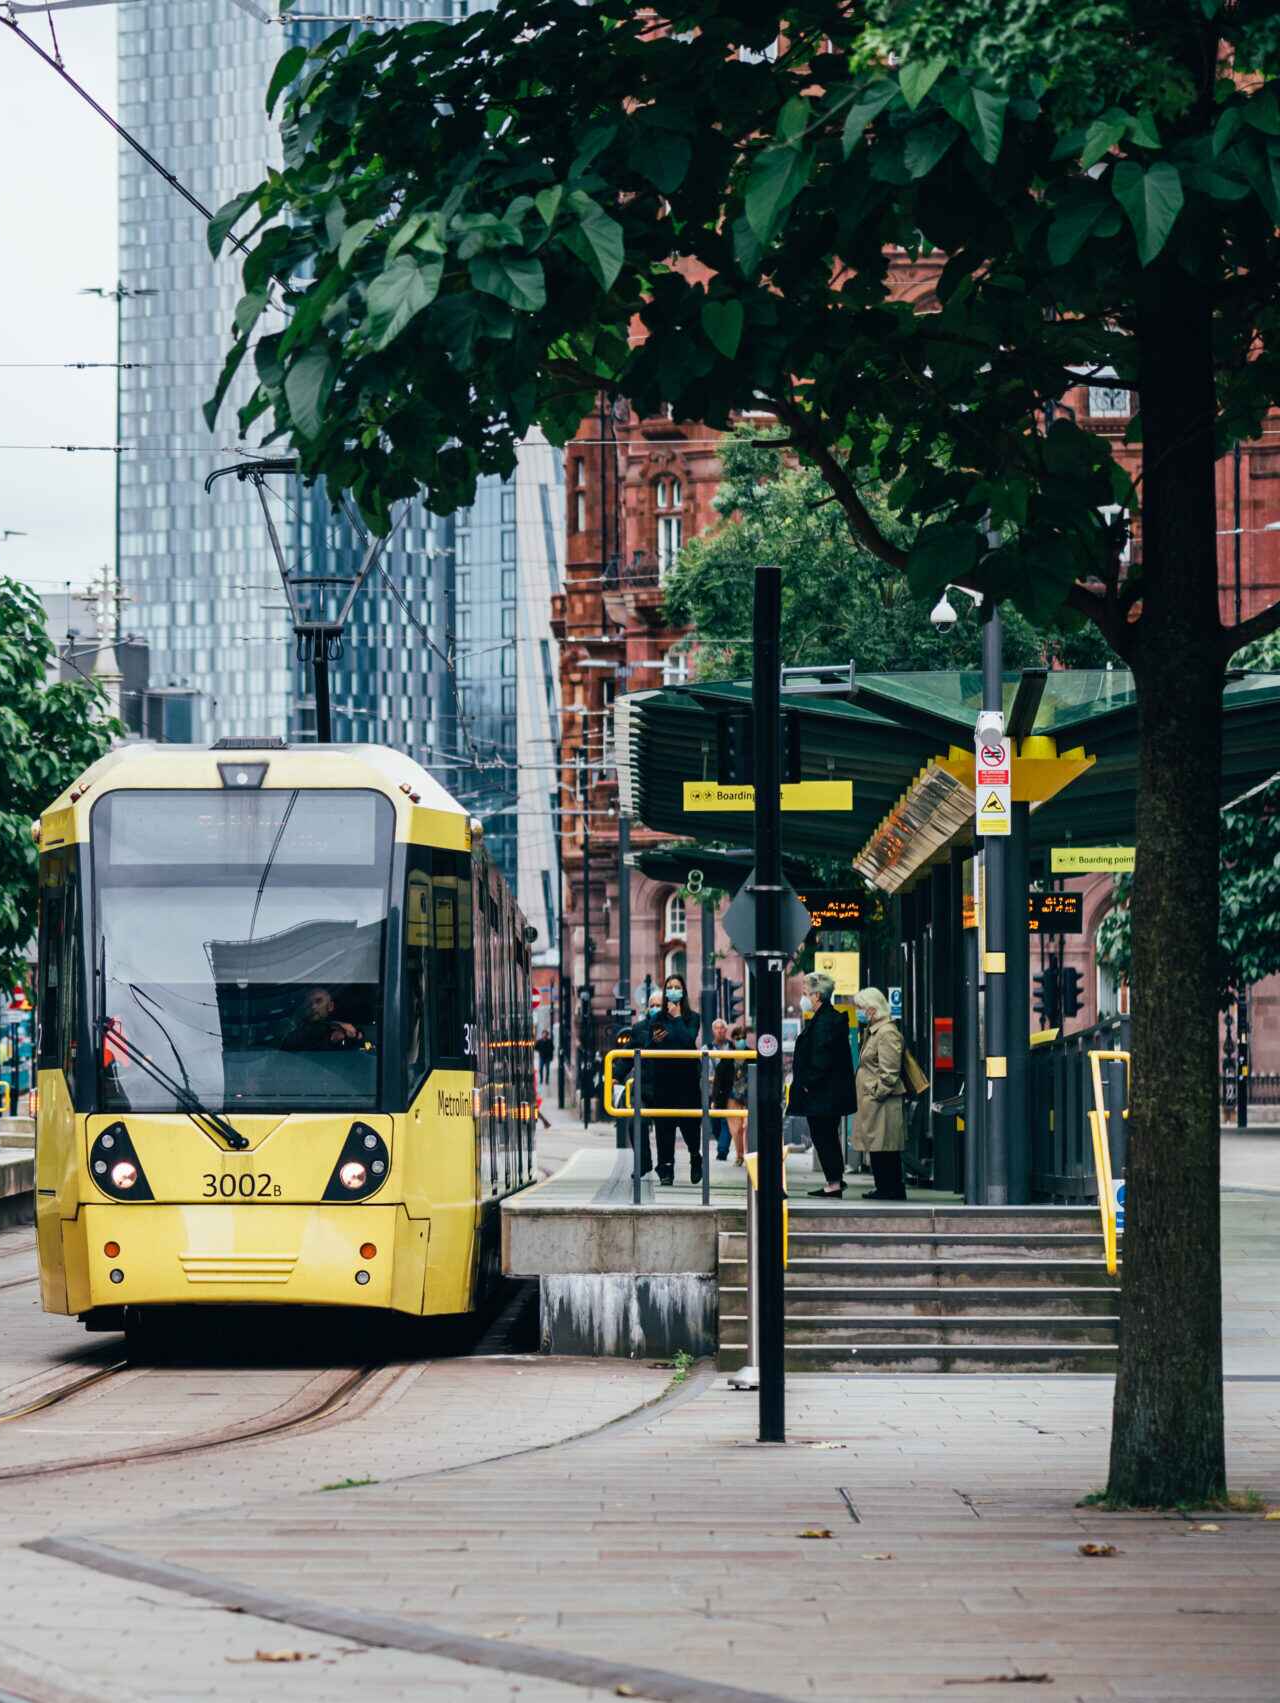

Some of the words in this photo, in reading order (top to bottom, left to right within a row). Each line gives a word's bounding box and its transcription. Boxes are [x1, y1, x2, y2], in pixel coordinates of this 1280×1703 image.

[717, 791, 754, 802] Boardin
[1078, 855, 1113, 865] Boarding
[1114, 855, 1134, 865] point
[437, 1089, 473, 1118] Metrolin
[202, 1173, 282, 1197] 3002B
